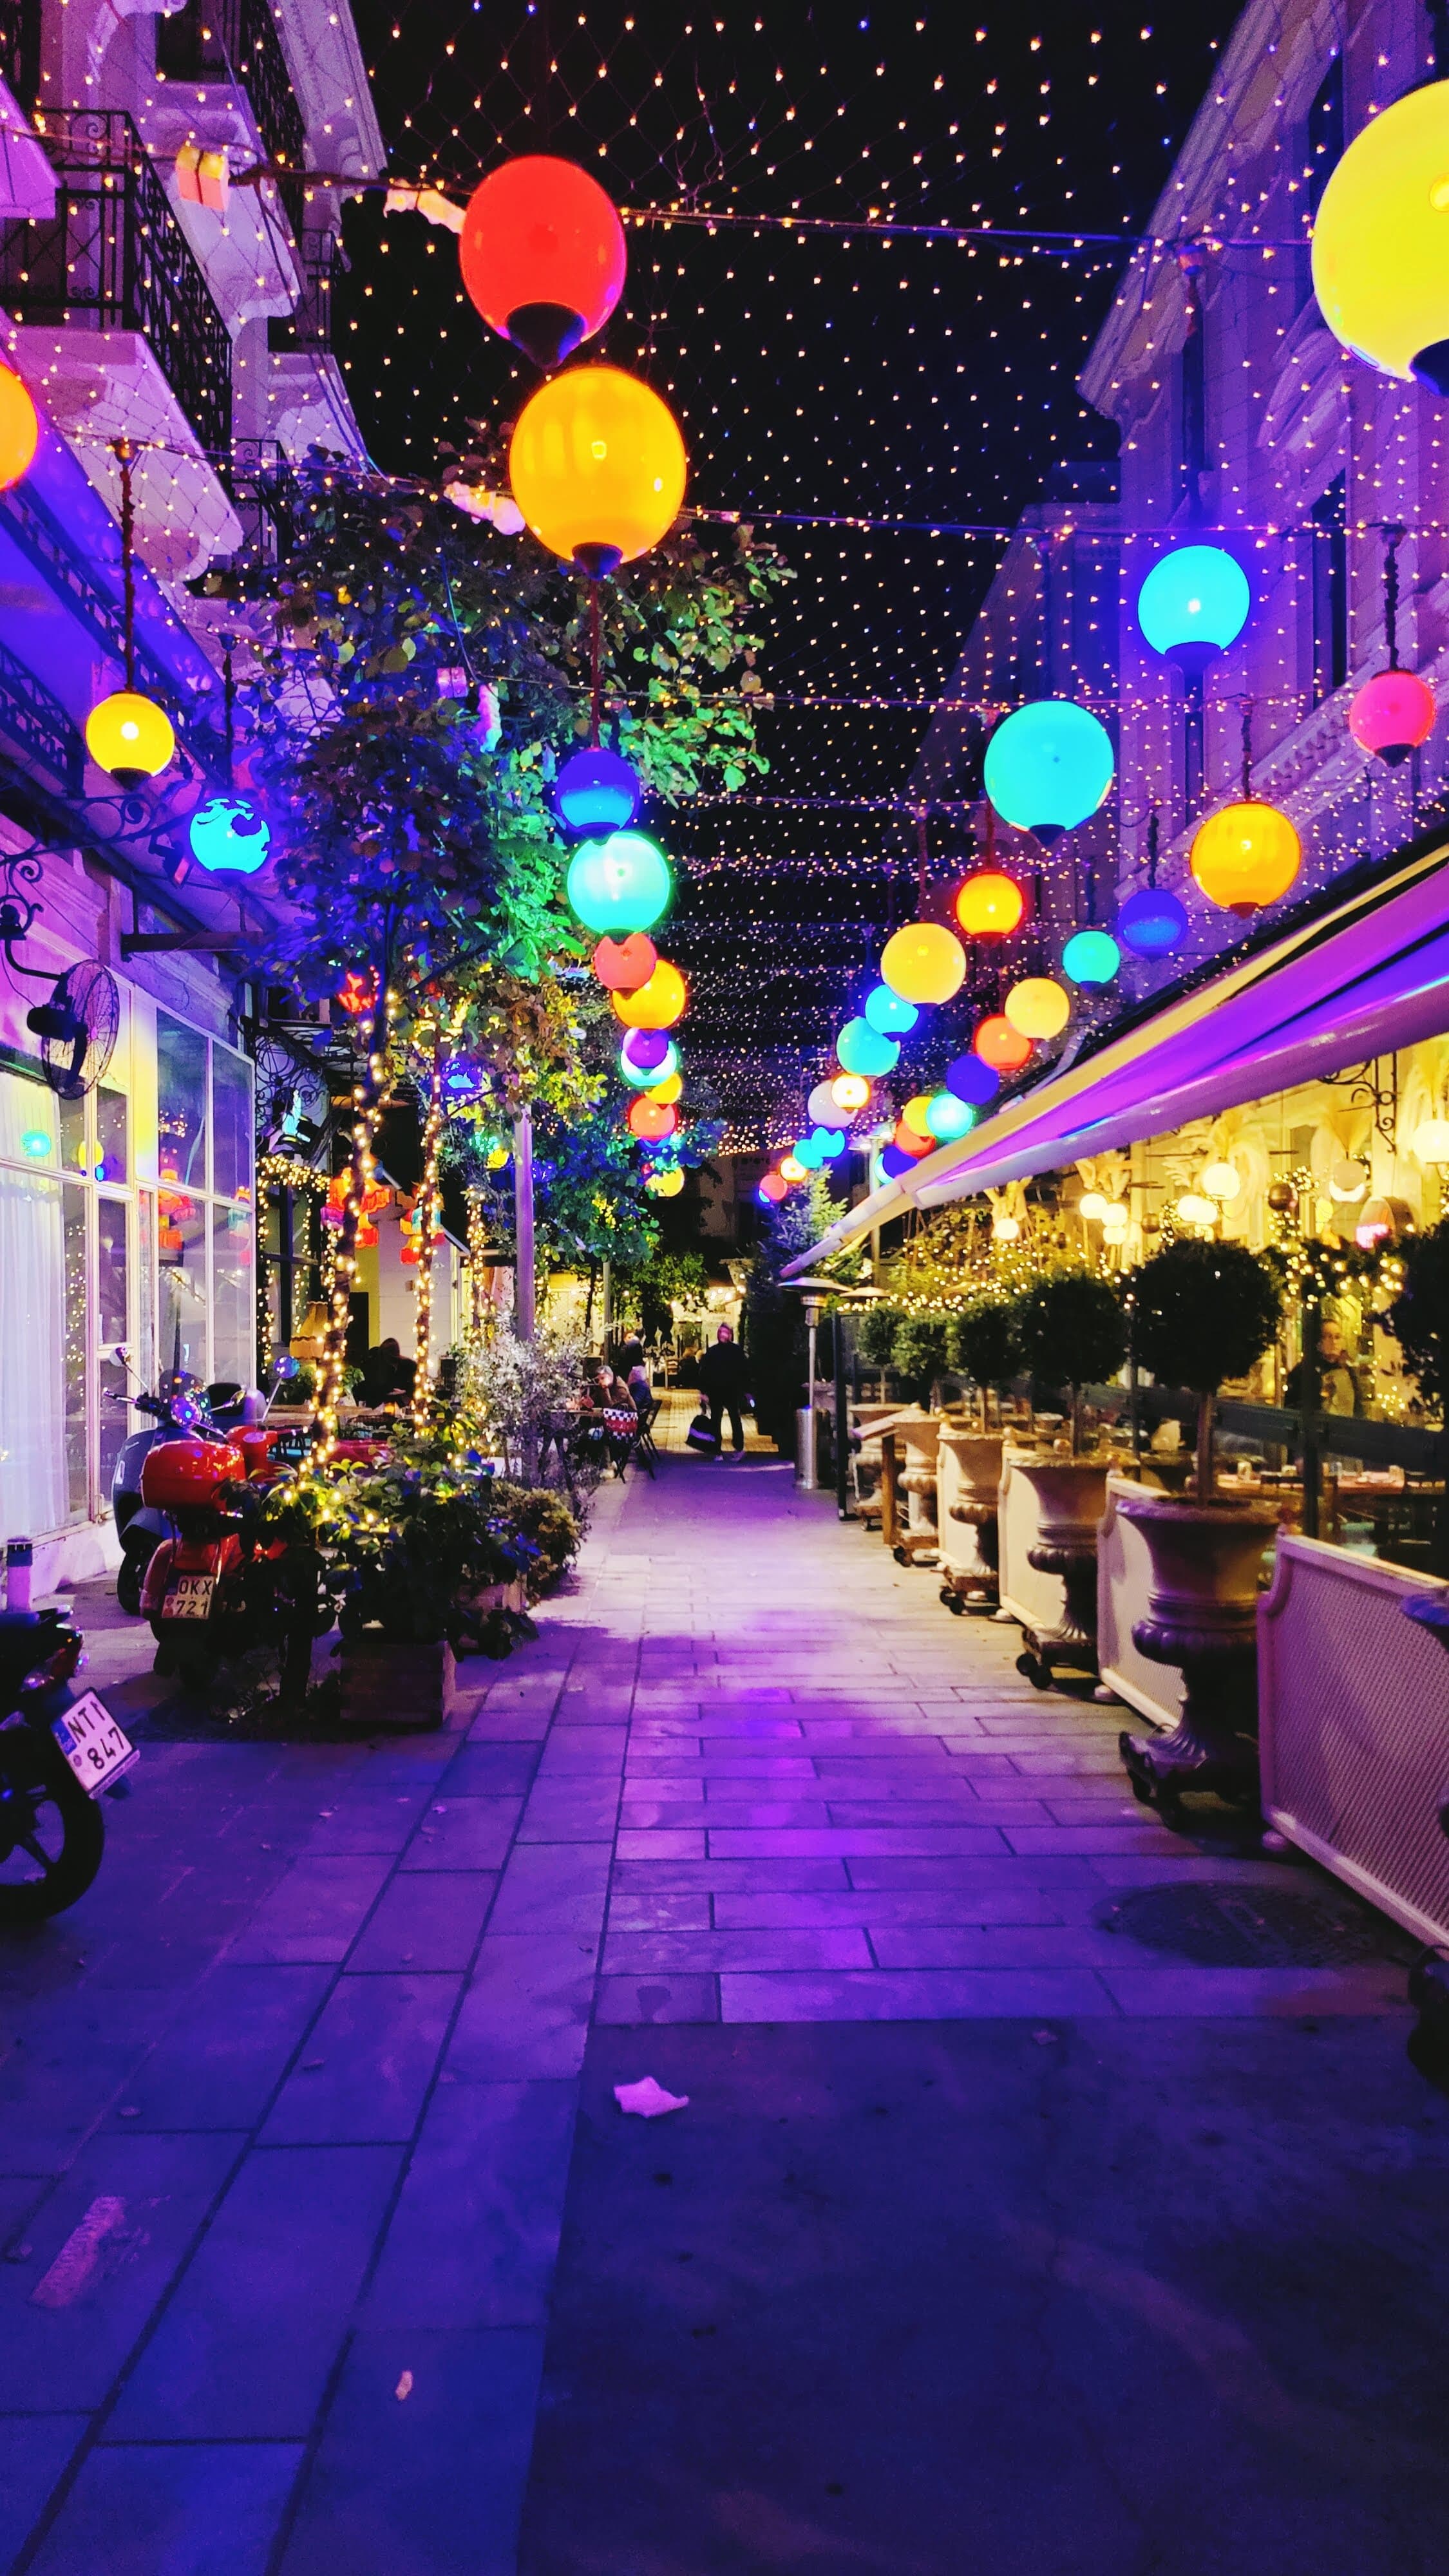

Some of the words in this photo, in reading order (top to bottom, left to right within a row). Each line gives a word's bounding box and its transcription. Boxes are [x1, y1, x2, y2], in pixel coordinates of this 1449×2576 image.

[180, 1580, 212, 1595] OKX
[176, 1600, 208, 1615] 721
[88, 1727, 124, 1770] 847
